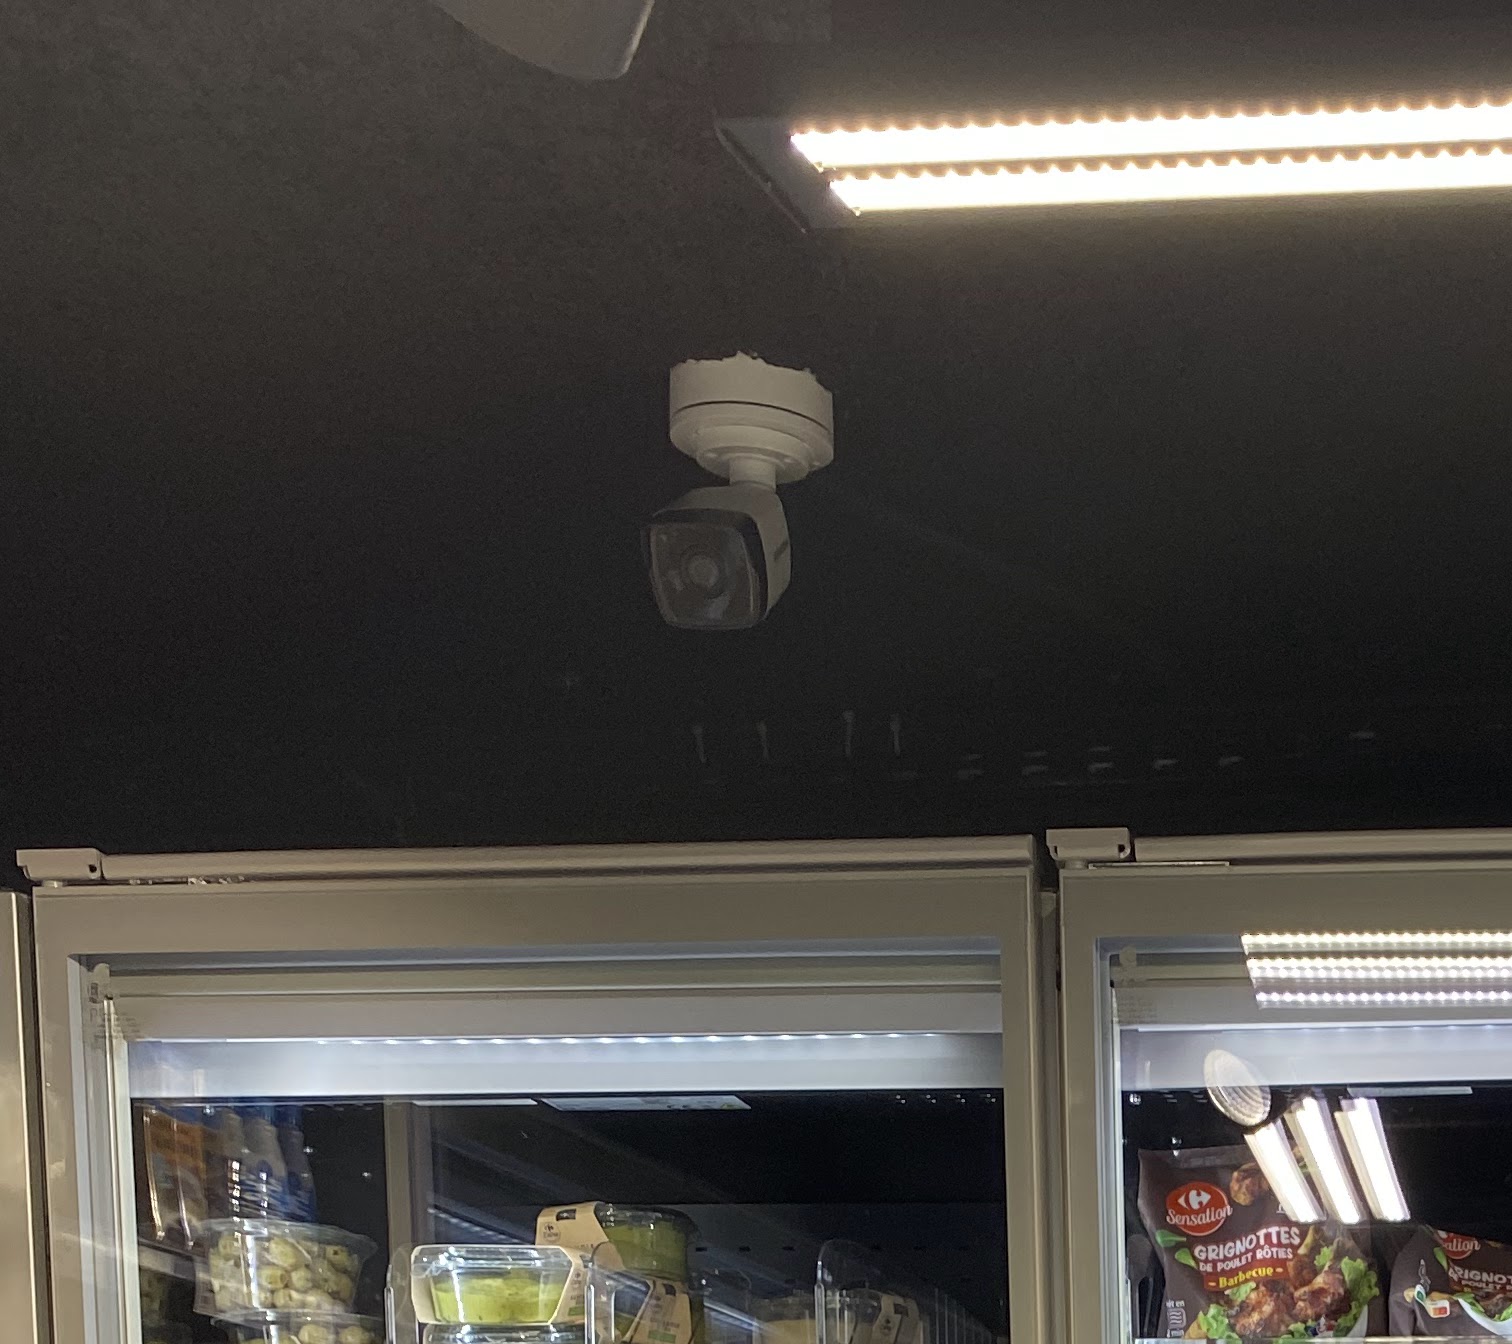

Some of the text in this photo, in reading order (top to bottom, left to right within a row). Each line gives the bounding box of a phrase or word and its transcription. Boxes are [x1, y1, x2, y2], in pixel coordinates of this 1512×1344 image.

[1165, 1203, 1234, 1227] Sensation
[1193, 1226, 1301, 1261] GRIGNOTTES
[1199, 1244, 1294, 1274] DE POULET RÔTIES
[1217, 1266, 1275, 1289] Barbecue
